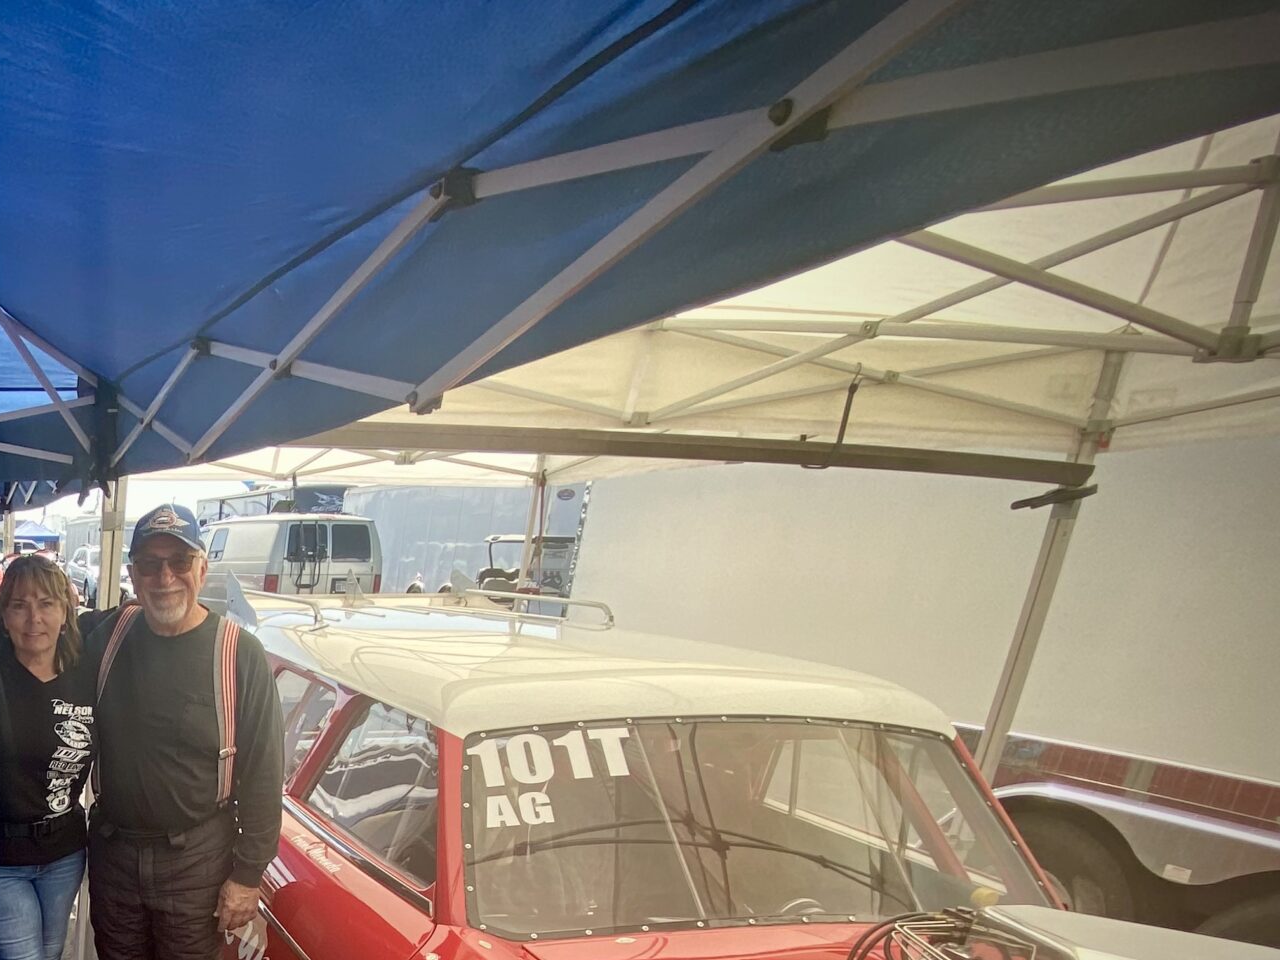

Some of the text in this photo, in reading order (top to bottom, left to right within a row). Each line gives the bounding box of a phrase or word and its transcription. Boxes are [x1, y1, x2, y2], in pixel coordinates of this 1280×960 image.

[53, 705, 93, 716] NELSON
[466, 727, 630, 788] 101T
[486, 791, 555, 828] AG
